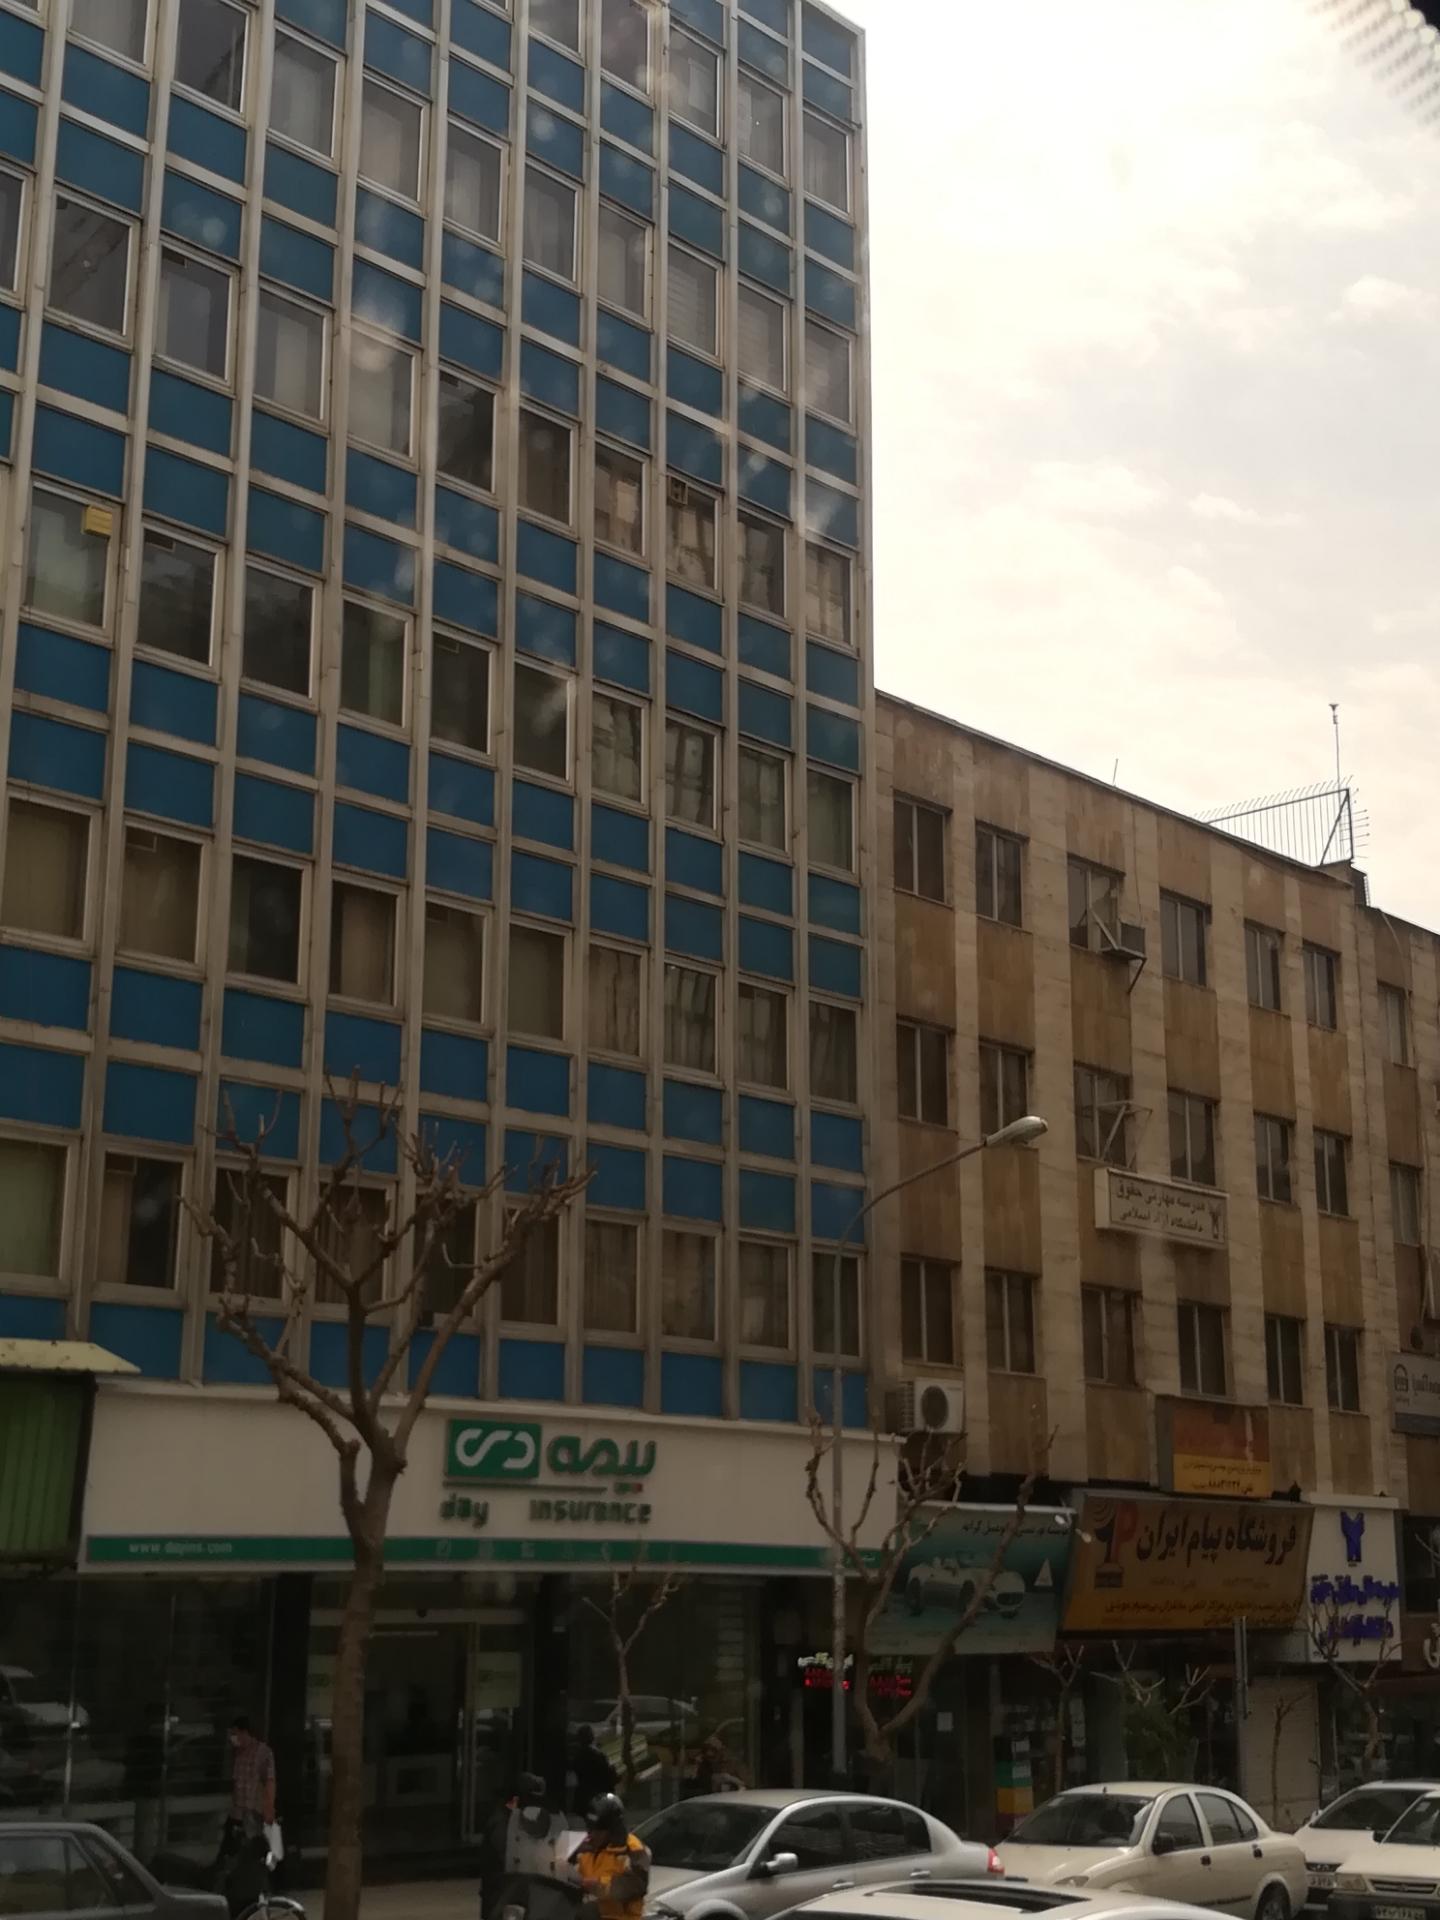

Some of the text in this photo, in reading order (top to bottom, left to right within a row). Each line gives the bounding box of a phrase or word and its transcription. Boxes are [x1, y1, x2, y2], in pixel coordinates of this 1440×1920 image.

[546, 1435, 657, 1494] بیمه
[440, 1493, 652, 1528] day insurance
[1136, 1508, 1297, 1568] فروشگاه پیام ایران
